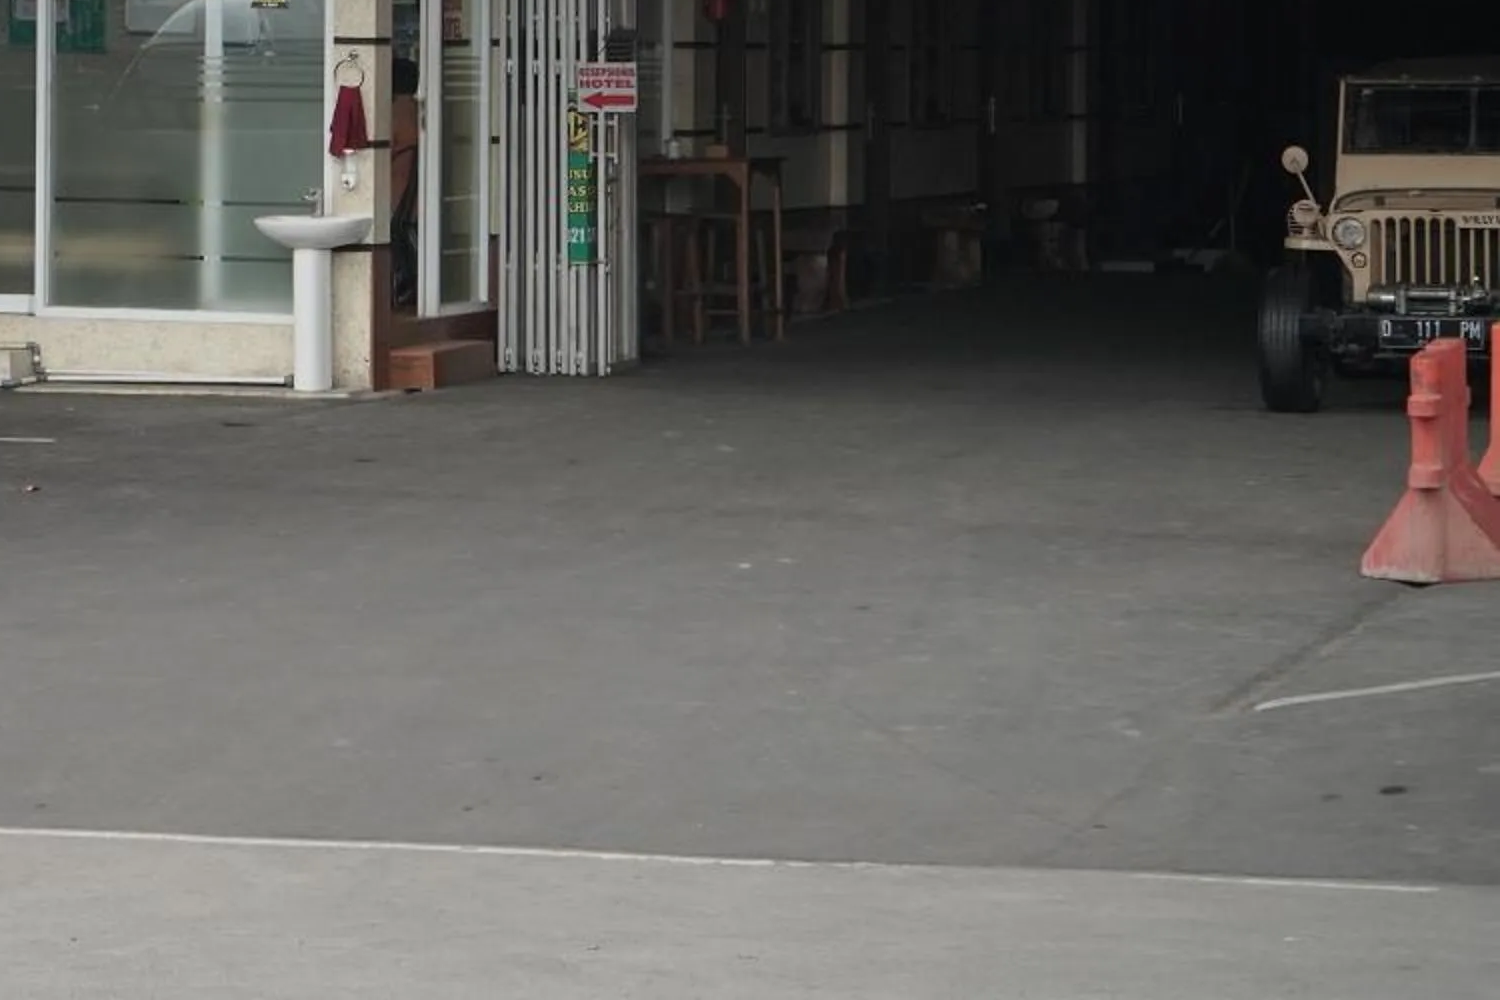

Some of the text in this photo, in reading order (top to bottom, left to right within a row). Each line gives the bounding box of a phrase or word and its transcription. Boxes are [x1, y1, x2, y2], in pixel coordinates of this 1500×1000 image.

[579, 78, 635, 89] HOTEL
[1380, 319, 1481, 339] D 111 PM
